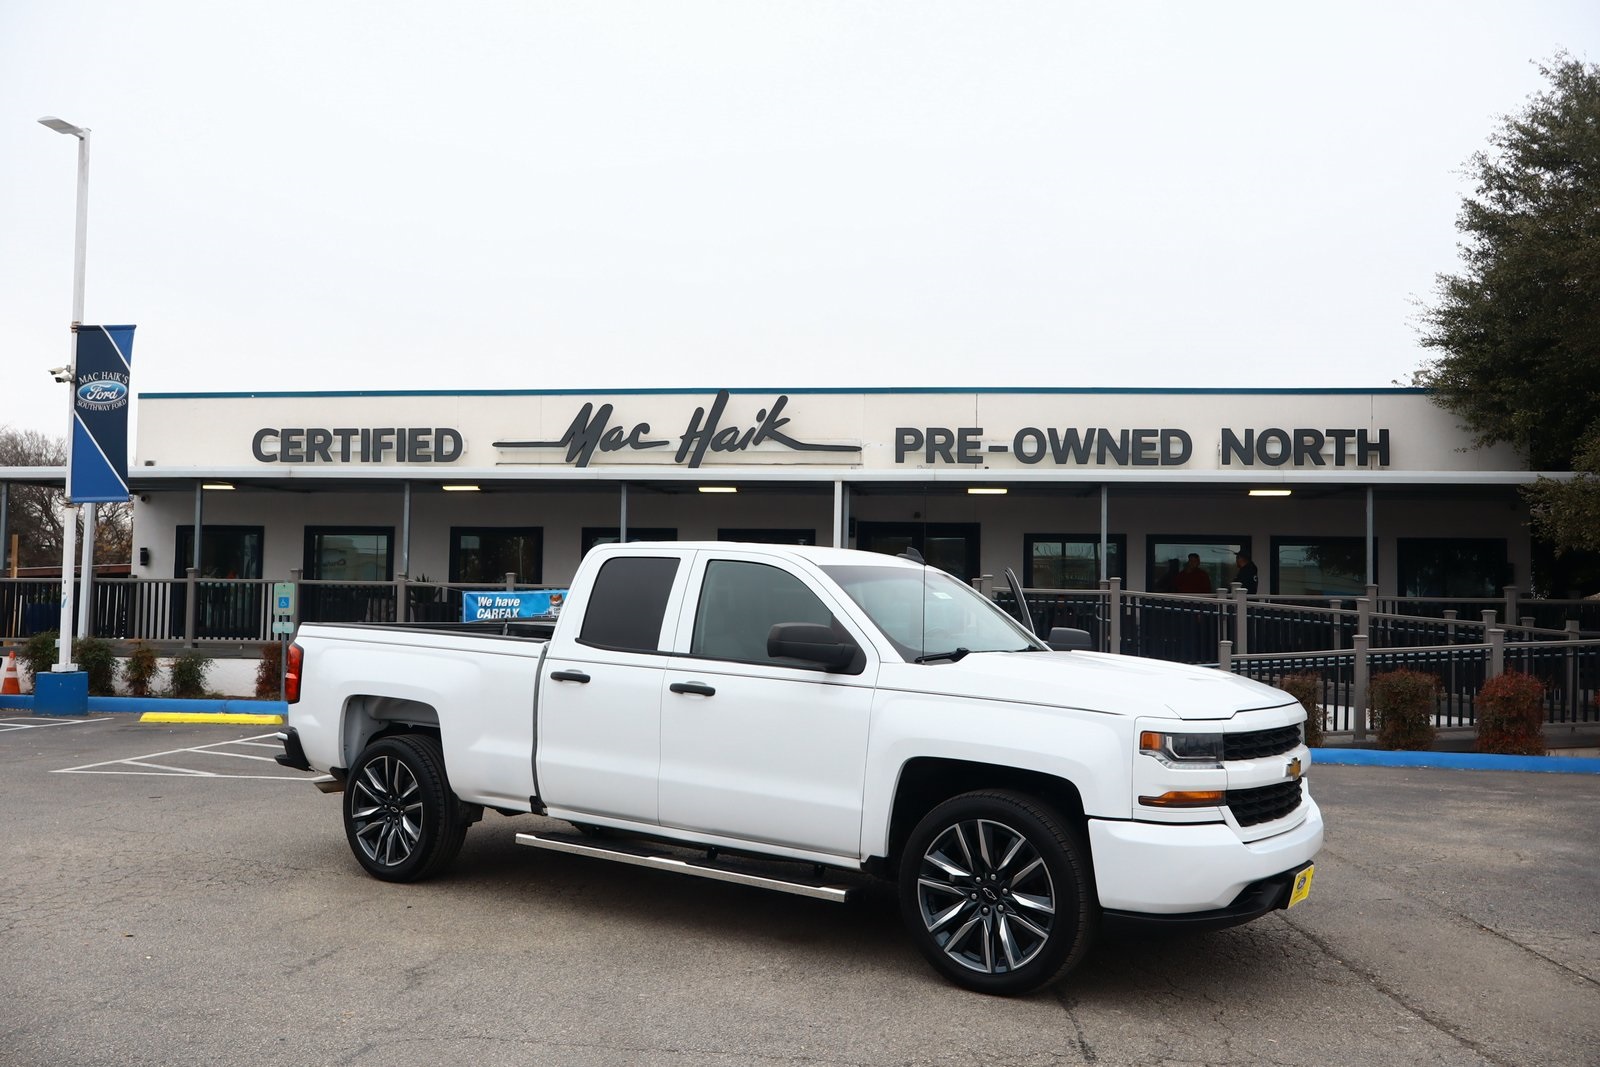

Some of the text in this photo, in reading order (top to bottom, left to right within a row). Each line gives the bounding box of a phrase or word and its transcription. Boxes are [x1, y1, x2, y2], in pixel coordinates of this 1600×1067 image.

[78, 371, 128, 384] MAC HAIK'S
[87, 384, 118, 399] Ford
[77, 398, 127, 411] SOUTHWAY FORD
[493, 389, 862, 468] Mac Haik
[252, 427, 463, 463] CERTIFIED
[895, 427, 1390, 467] PRE-OWNED NORTH
[477, 596, 521, 607] We have
[476, 608, 520, 618] CARFAX
